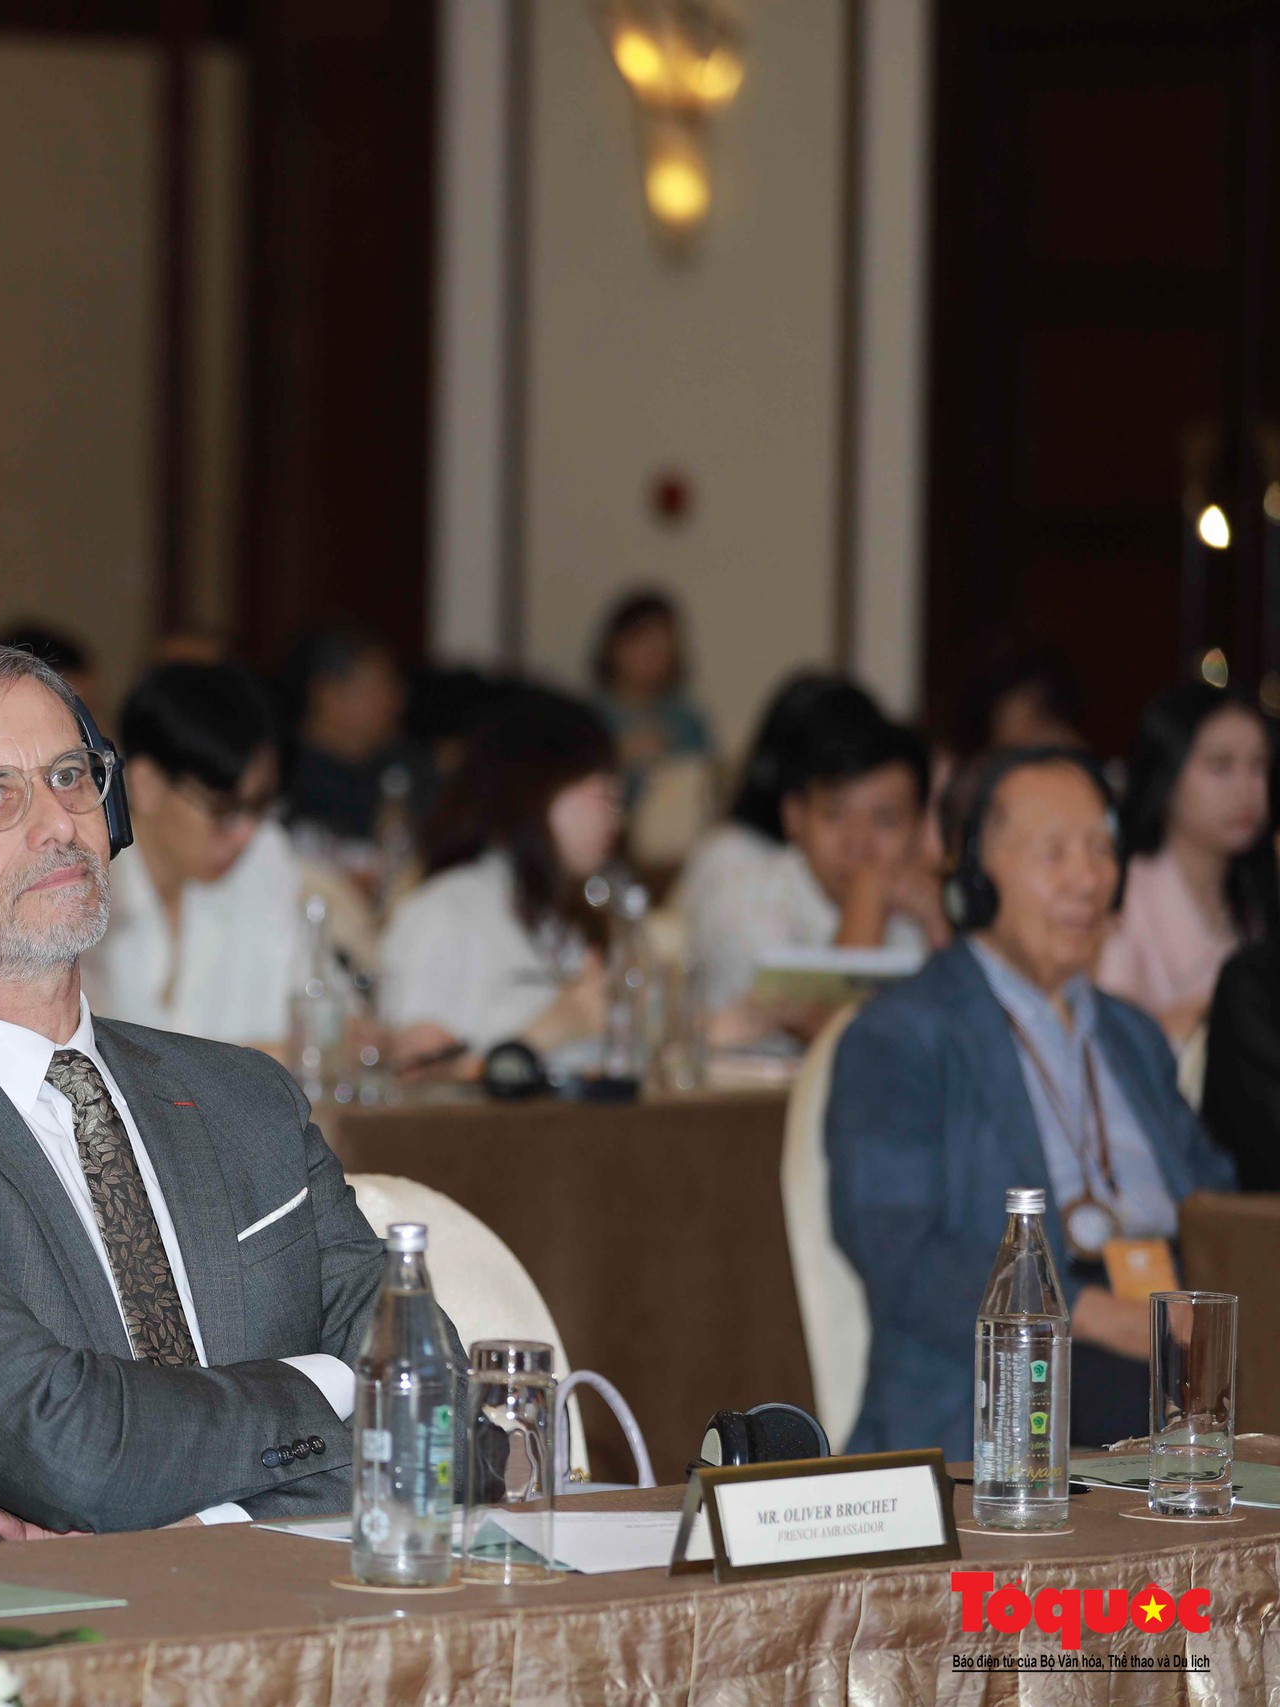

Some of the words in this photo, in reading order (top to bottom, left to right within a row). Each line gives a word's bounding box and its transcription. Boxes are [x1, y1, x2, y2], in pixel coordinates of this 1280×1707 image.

[757, 1510, 780, 1525] MR.
[783, 1504, 832, 1523] OLIVER
[836, 1498, 898, 1518] BROCHET
[777, 1527, 818, 1542] FRENCH
[822, 1520, 885, 1538] AMBASSADOR
